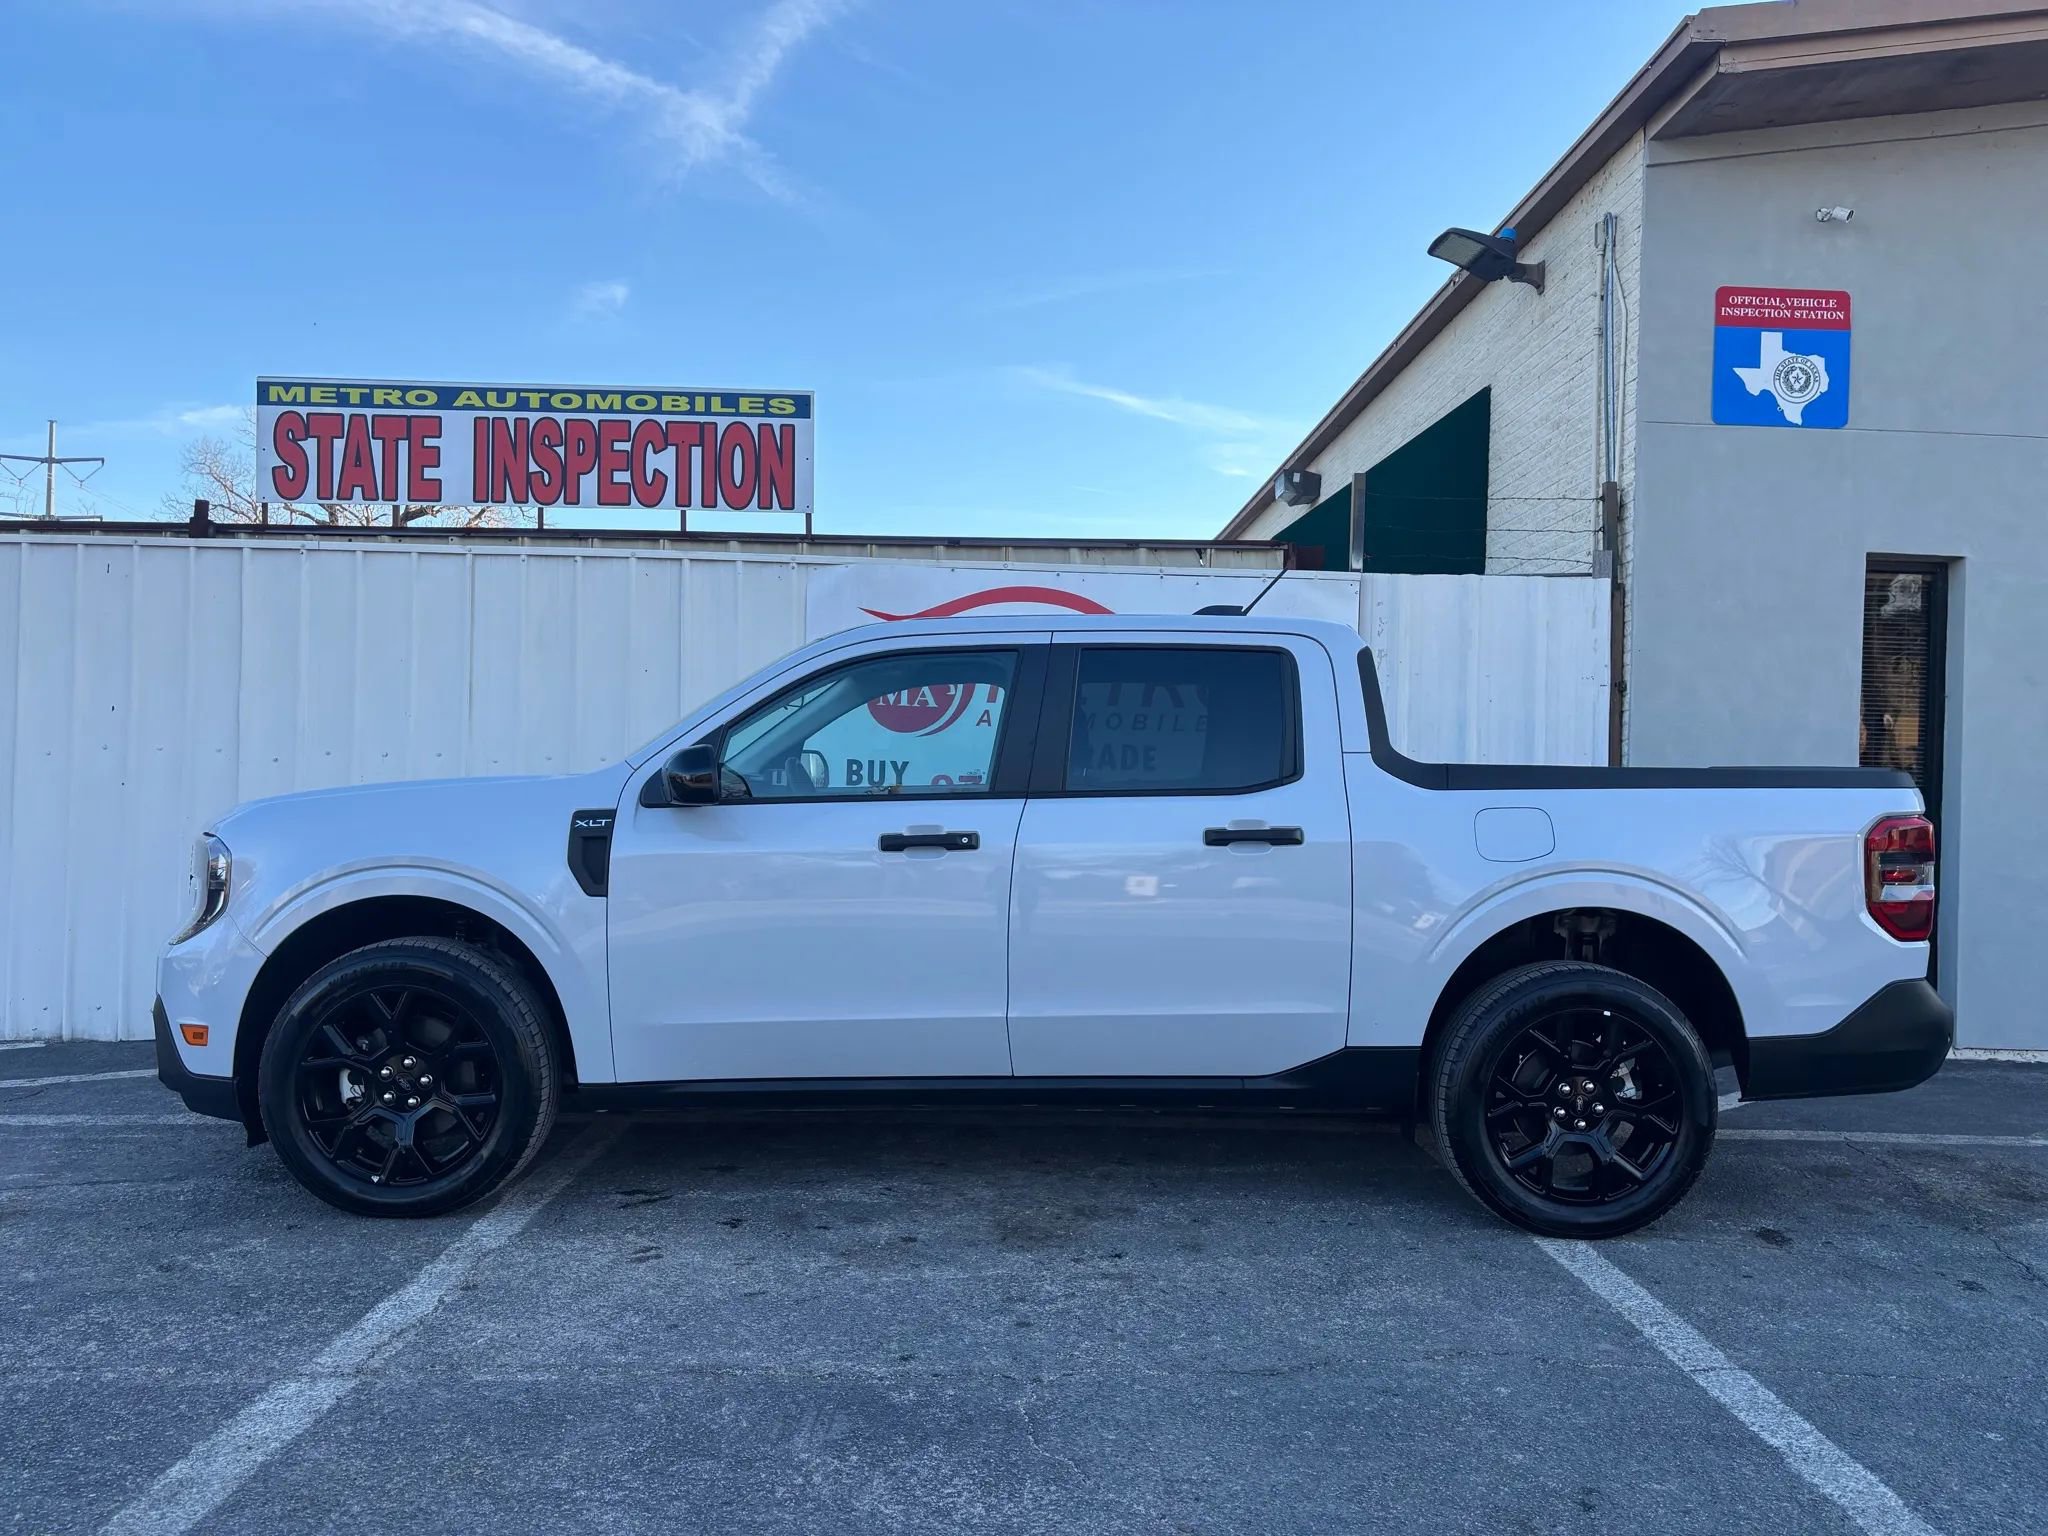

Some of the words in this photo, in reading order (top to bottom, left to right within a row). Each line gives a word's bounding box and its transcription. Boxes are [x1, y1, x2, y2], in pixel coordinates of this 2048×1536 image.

[1729, 295, 1780, 306] OFFICIAL
[1786, 298, 1837, 308] VEHICLE
[1721, 307, 1791, 318] INSPECTION
[1794, 310, 1845, 320] STATION
[268, 385, 439, 407] METRO
[452, 390, 797, 415] AUTOMOBILES
[271, 410, 443, 502] STATE
[473, 415, 797, 510] INSPECTION
[846, 758, 909, 786] BUY
[574, 818, 612, 828] XLT
